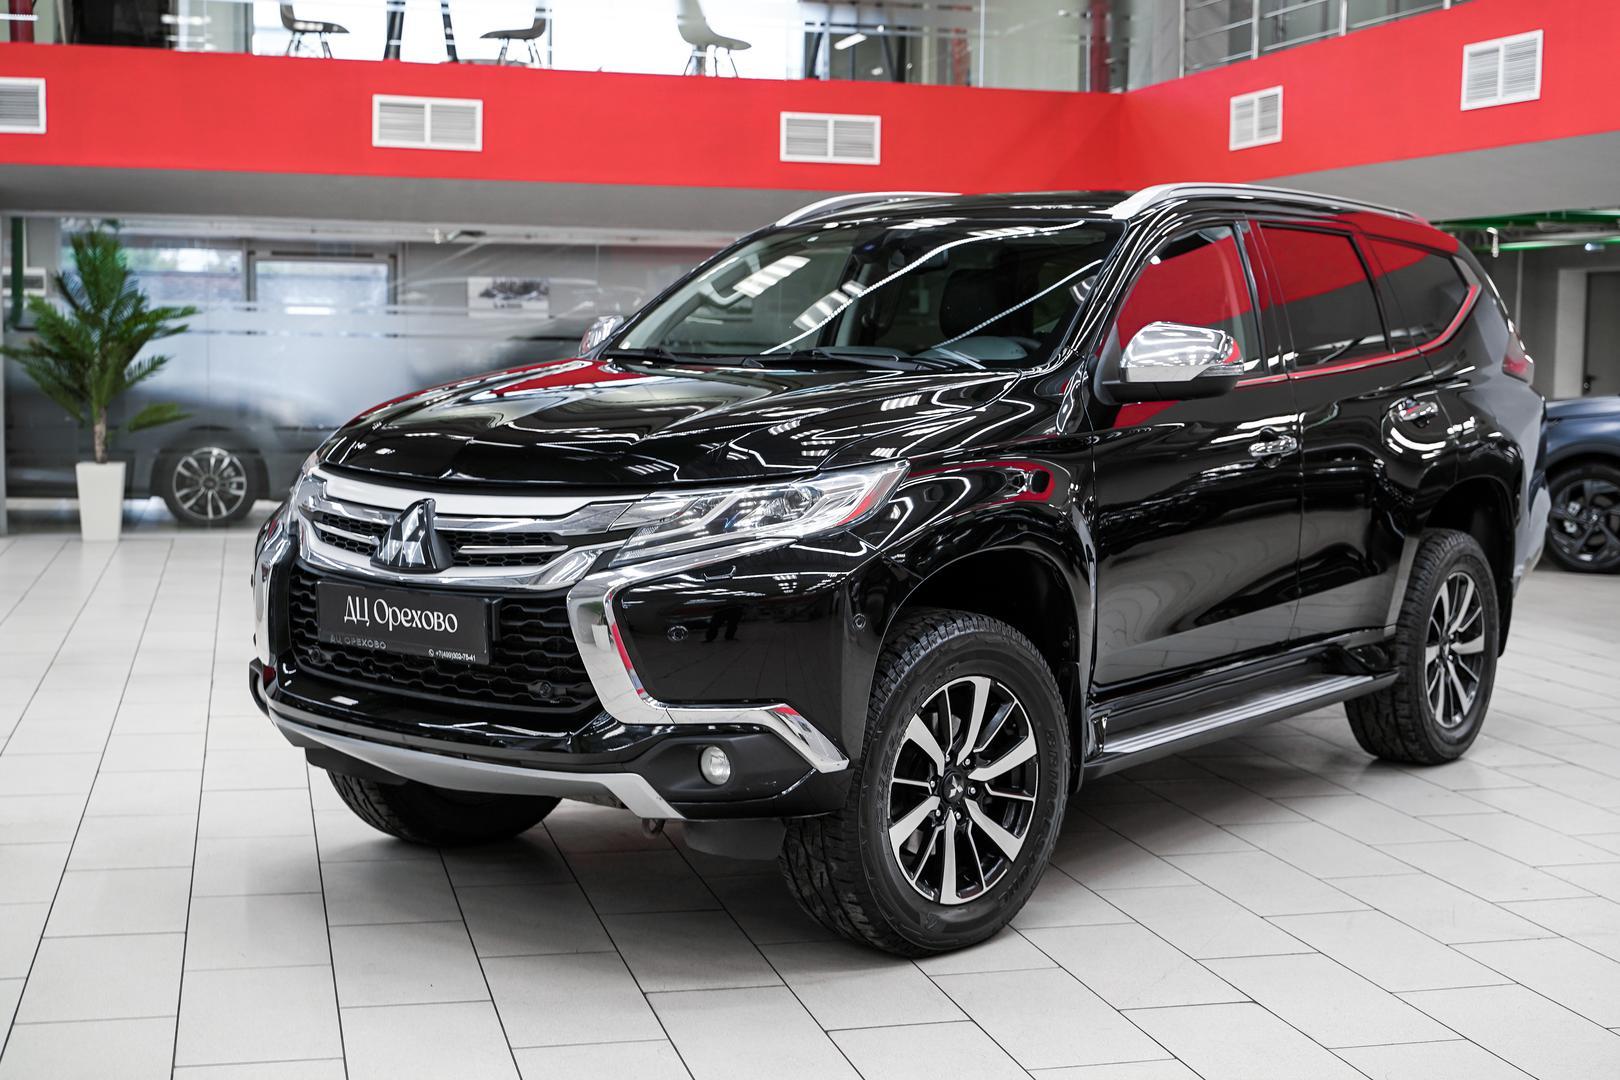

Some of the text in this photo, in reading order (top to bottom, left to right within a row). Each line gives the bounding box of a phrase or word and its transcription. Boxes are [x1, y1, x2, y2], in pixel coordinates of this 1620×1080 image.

[344, 595, 458, 633] ДЦ Орехово
[330, 633, 387, 650] ДЦ ОРЕХОВО
